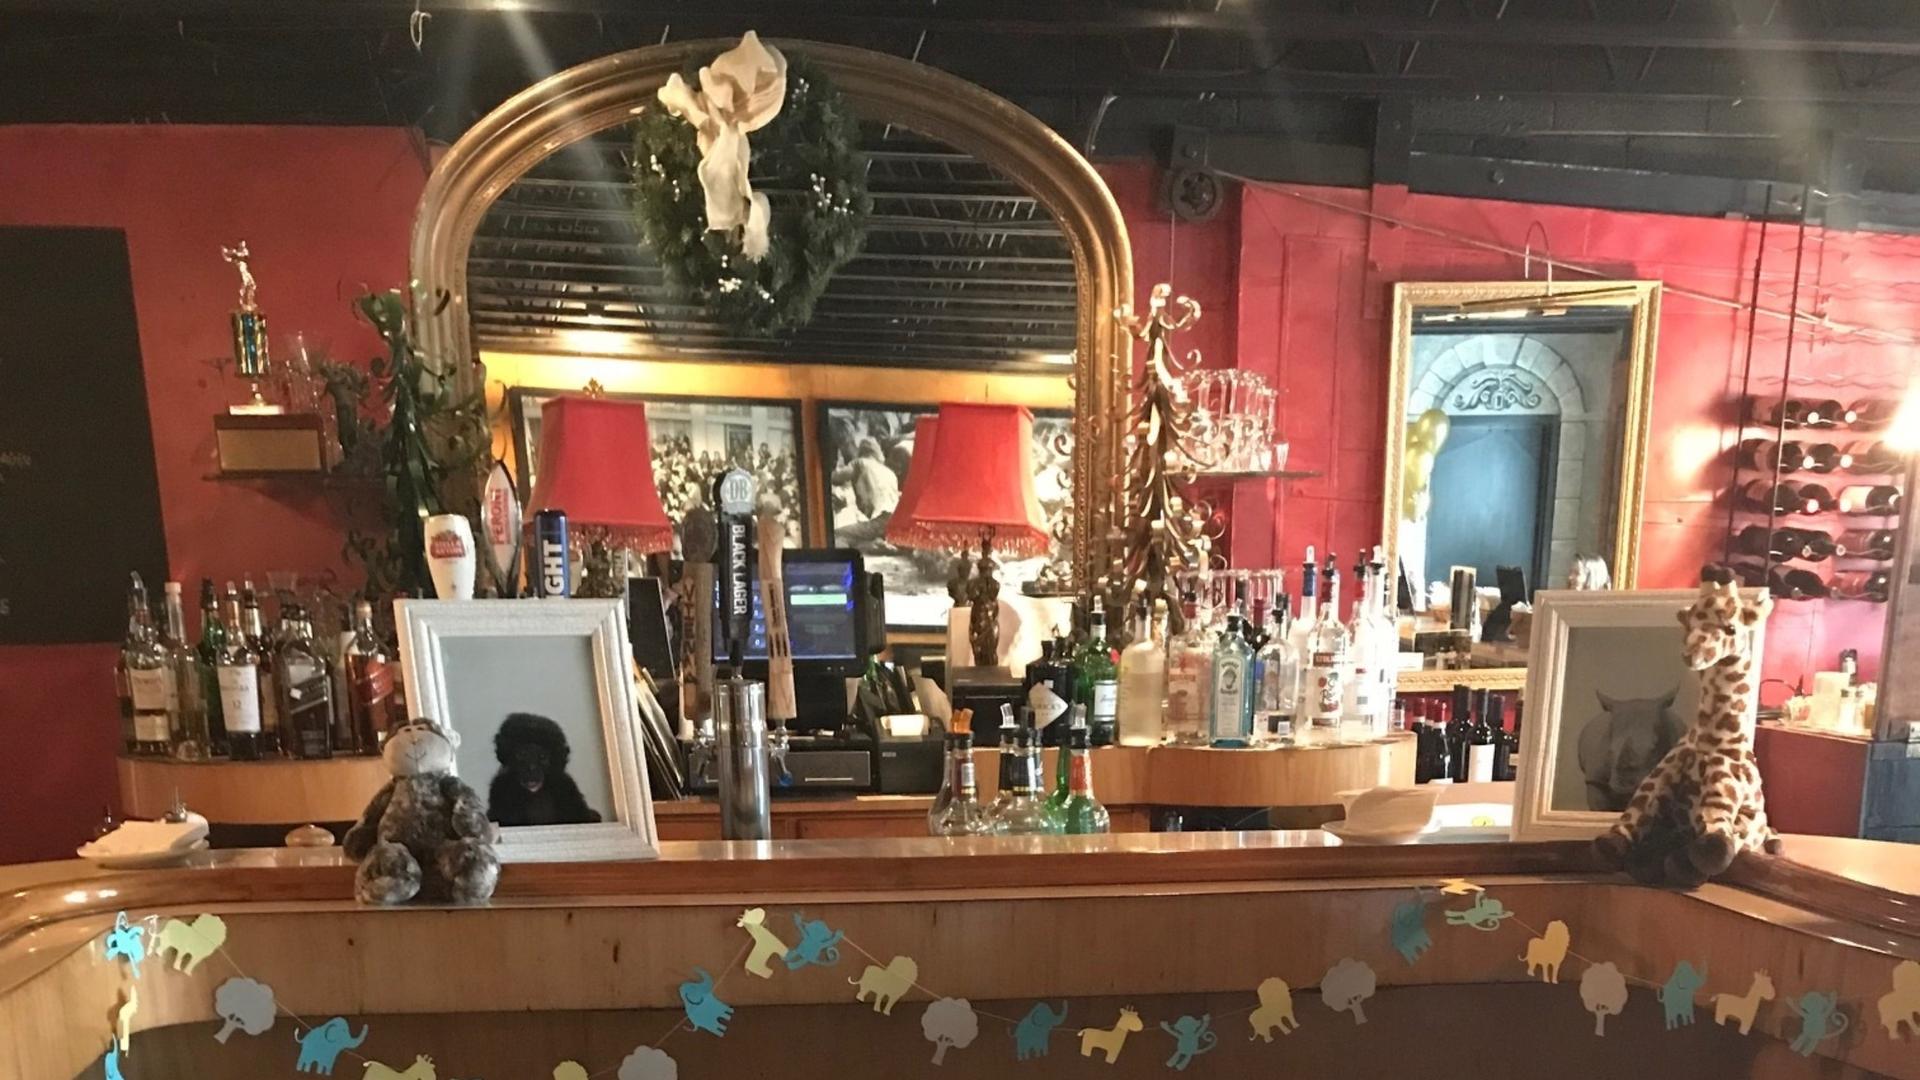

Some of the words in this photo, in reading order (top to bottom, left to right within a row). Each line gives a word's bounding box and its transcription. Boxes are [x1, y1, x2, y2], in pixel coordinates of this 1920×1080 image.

[490, 488, 504, 545] PERONI
[732, 525, 746, 569] BLACK
[733, 573, 747, 615] LAGER
